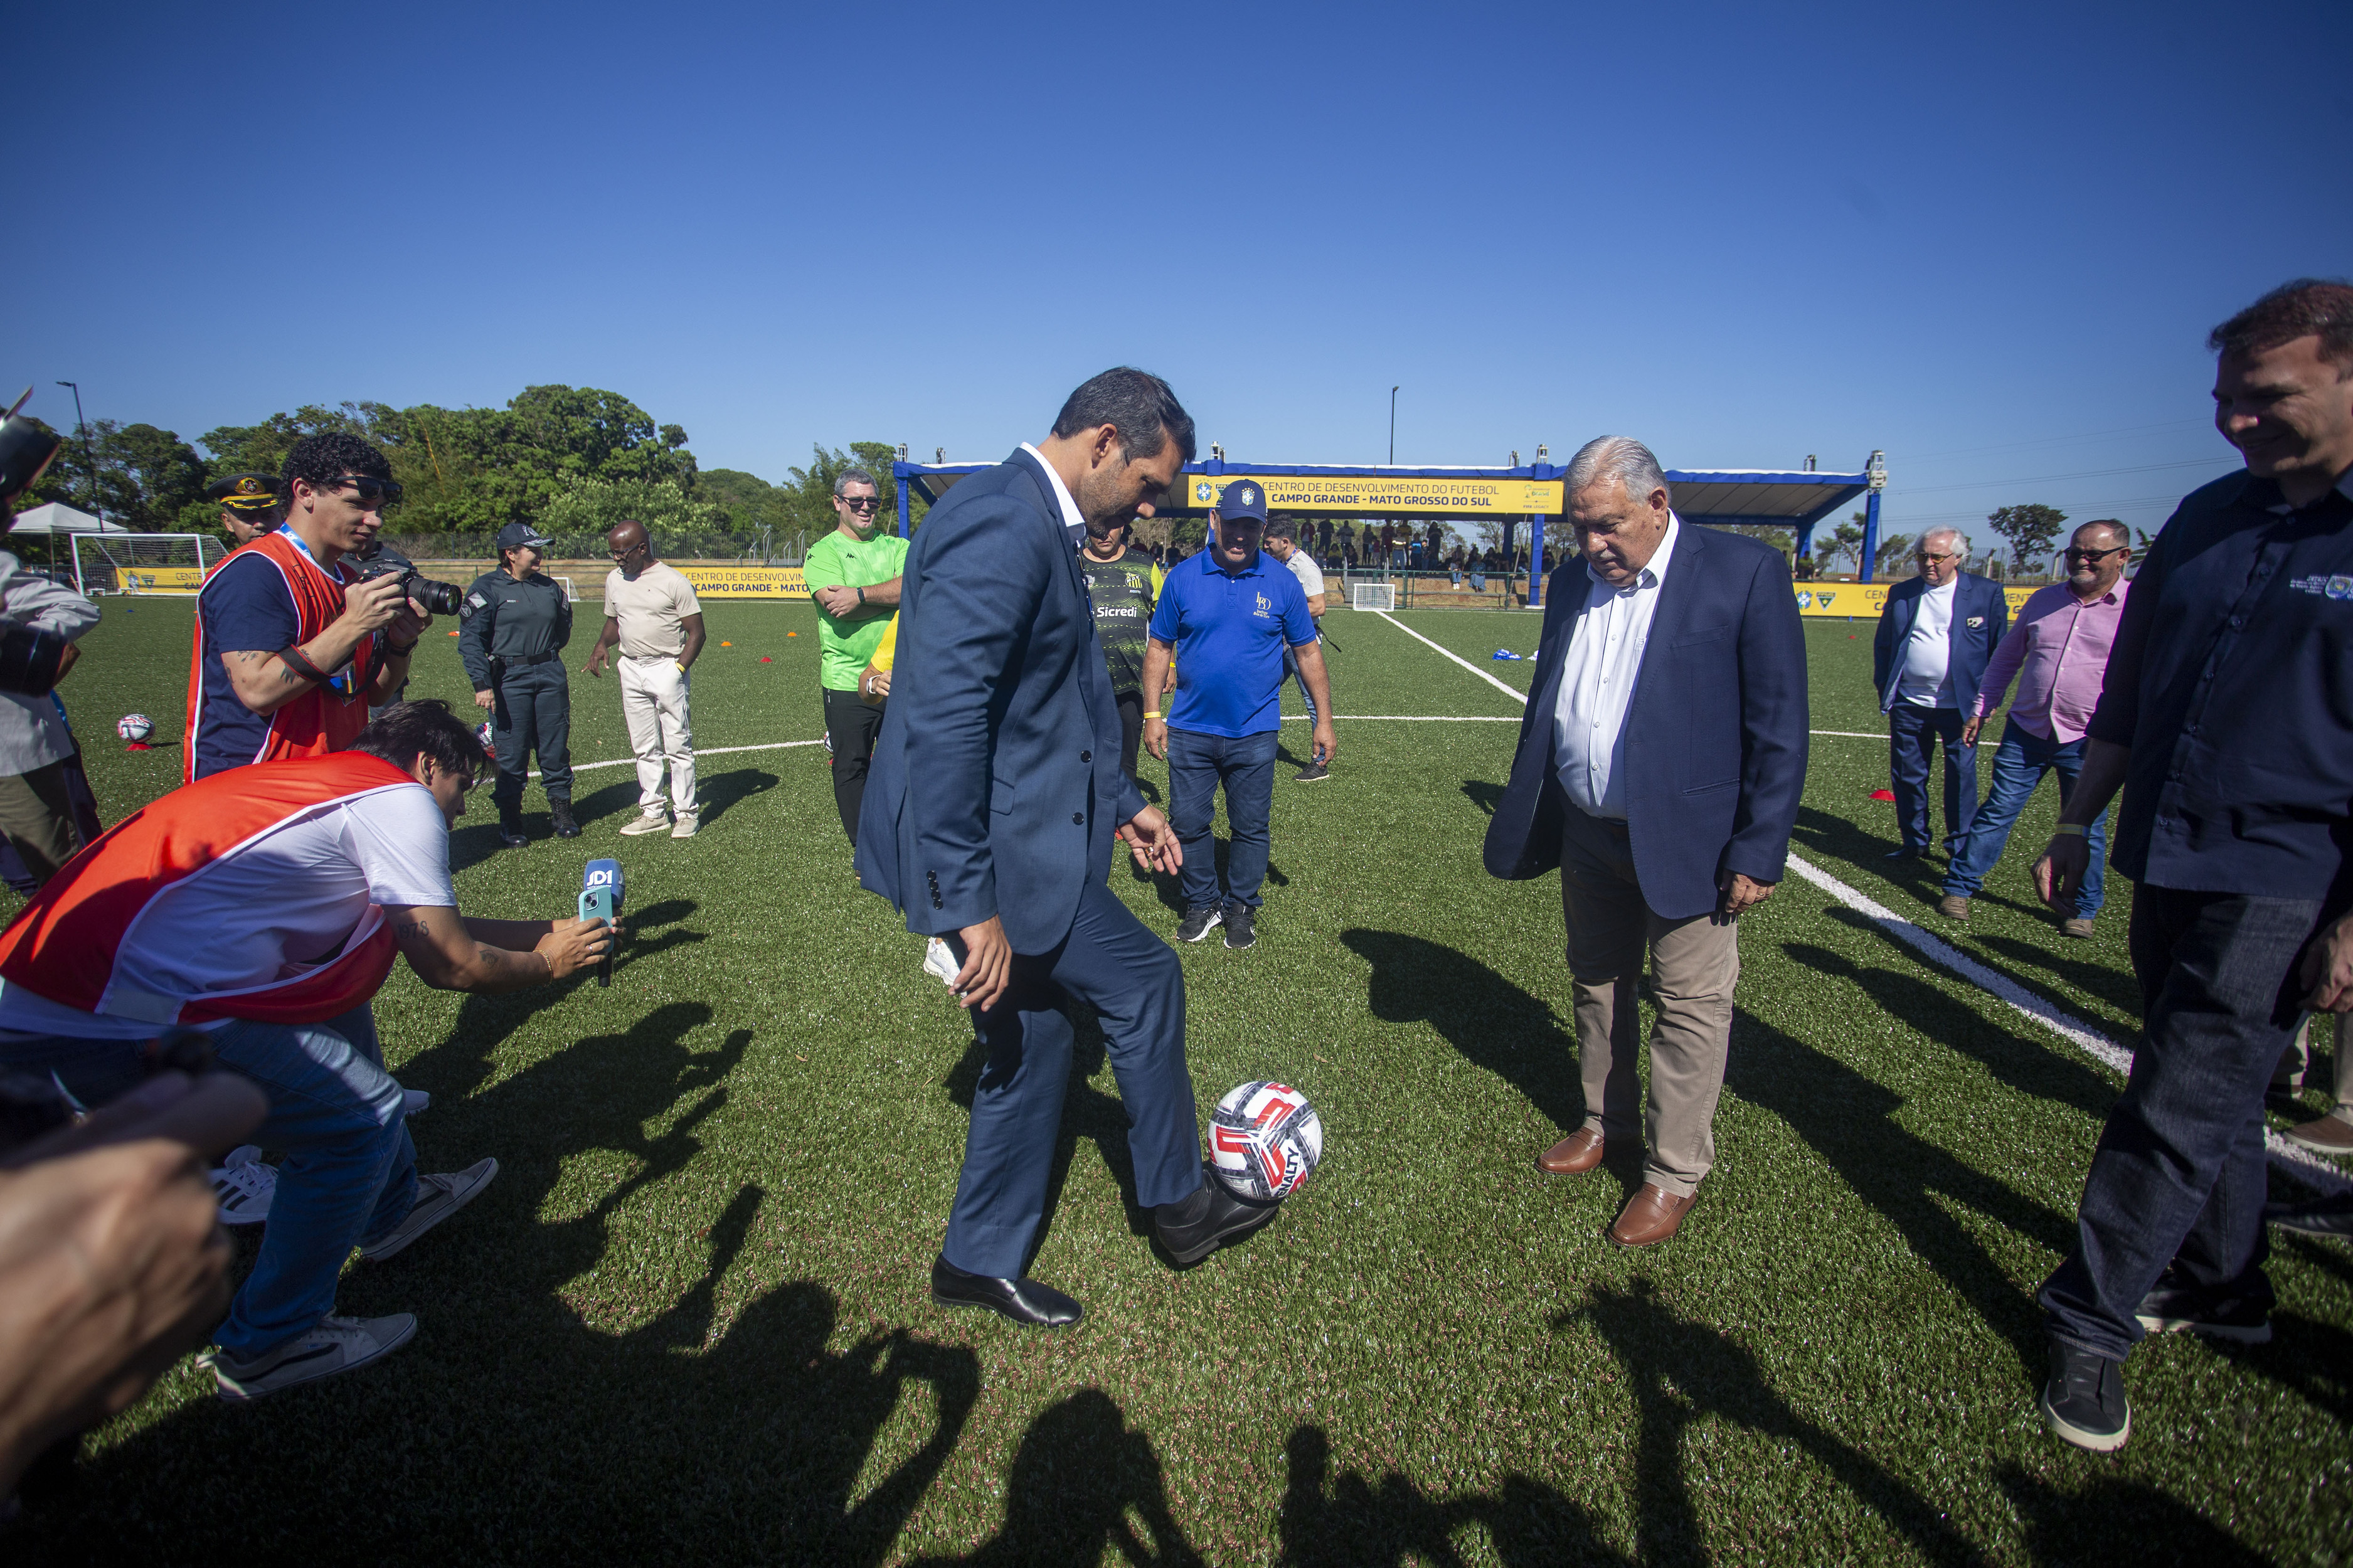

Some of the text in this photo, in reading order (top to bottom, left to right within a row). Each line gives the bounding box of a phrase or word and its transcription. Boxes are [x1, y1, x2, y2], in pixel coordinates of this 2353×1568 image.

[1262, 482, 1499, 494] CENTRO DE DESENVOLVIMENTO DO FUTEBOL
[1272, 494, 1311, 503] CAMPO
[1314, 495, 1360, 504] GRANDE
[1369, 495, 1401, 504] MATO
[1404, 496, 1449, 506] GROSSO
[1452, 497, 1468, 506] DO
[1470, 497, 1492, 506] SUL
[686, 572, 804, 581] CENTRO DE DESENVOLVIM
[695, 583, 729, 591] CAMPO
[731, 584, 772, 592] GRANDE
[780, 584, 809, 592] MATO
[1097, 607, 1137, 617] Sicredi
[587, 870, 613, 886] JD1
[1274, 1147, 1299, 1197] ENALTY
